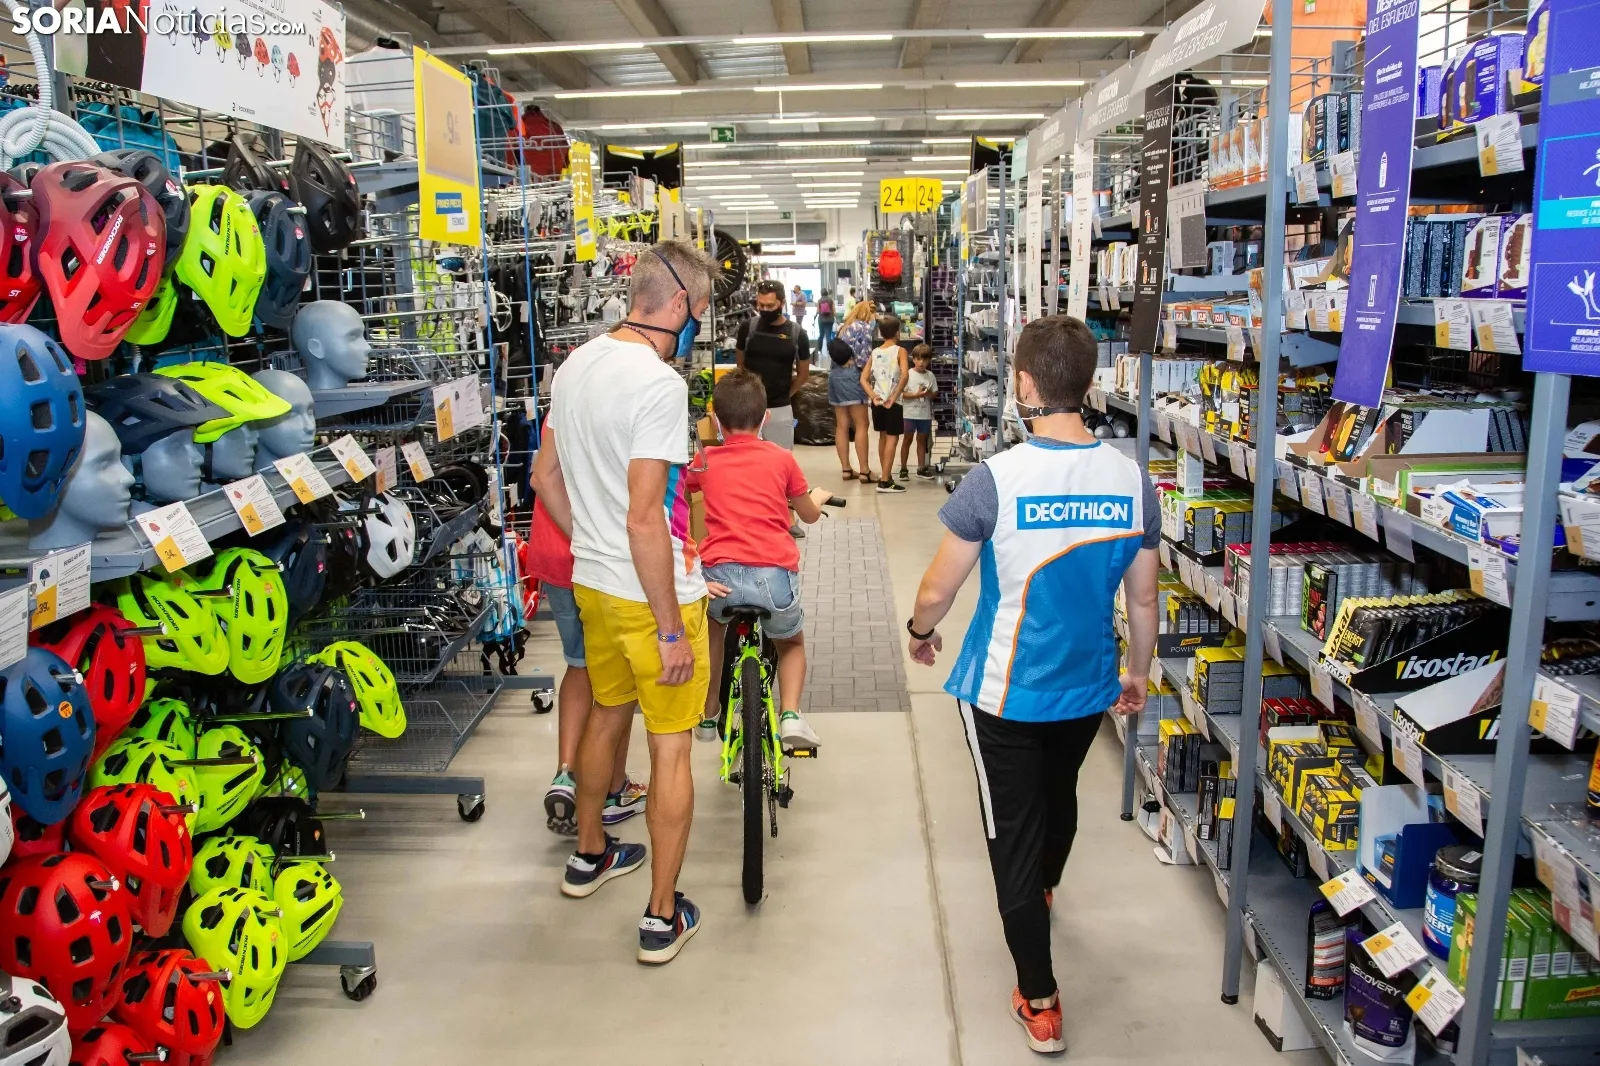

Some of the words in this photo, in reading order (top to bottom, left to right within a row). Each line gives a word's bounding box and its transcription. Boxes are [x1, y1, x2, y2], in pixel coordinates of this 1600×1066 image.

[1173, 3, 1216, 45] NUTRICIÓN
[1368, 16, 1380, 36] DEL
[1381, 1, 1418, 30] ESFUERZO
[1187, 20, 1228, 57] ESFUERZO
[96, 214, 123, 265] ROCKRIDER
[8, 289, 22, 297] ST
[1025, 501, 1128, 523] DECATHLON
[150, 596, 180, 631] ROCKRIDER
[1343, 629, 1366, 648] ENERGY
[1396, 710, 1424, 743] isostar
[238, 935, 249, 976] ROCKRIDER
[1349, 962, 1402, 997] RECOVERY
